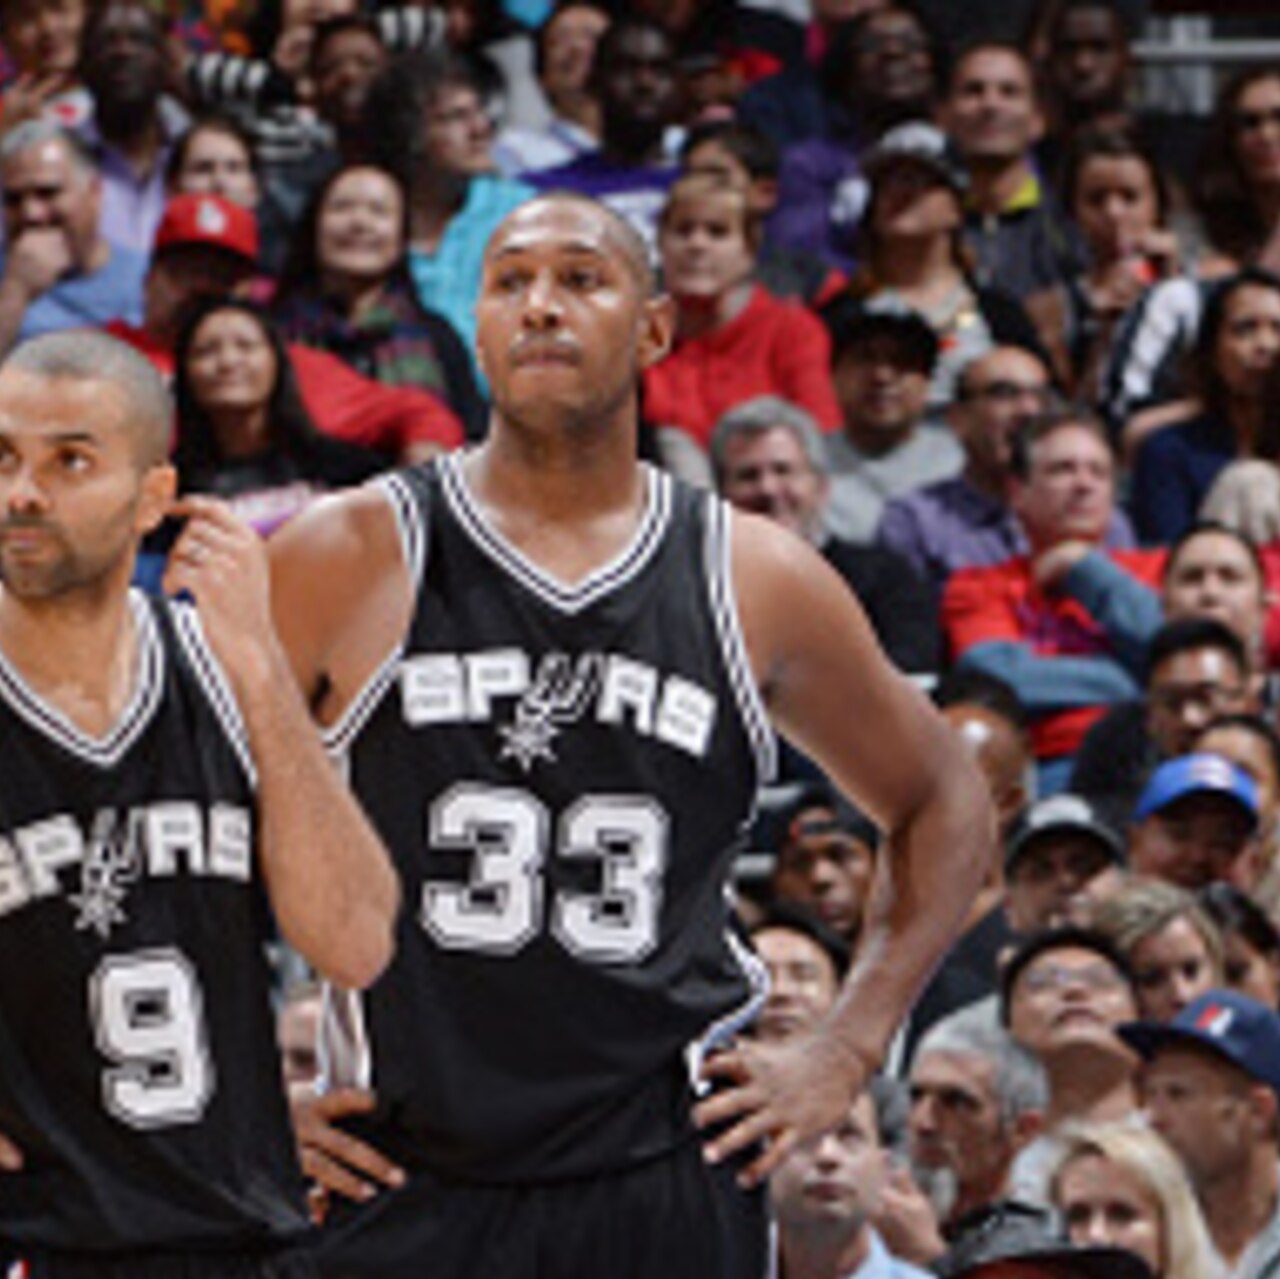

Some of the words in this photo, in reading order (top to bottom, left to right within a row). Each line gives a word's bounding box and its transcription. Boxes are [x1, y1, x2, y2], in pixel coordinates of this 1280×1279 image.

[401, 647, 716, 768] SPURS
[420, 781, 670, 962] 33
[88, 947, 214, 1129] 9
